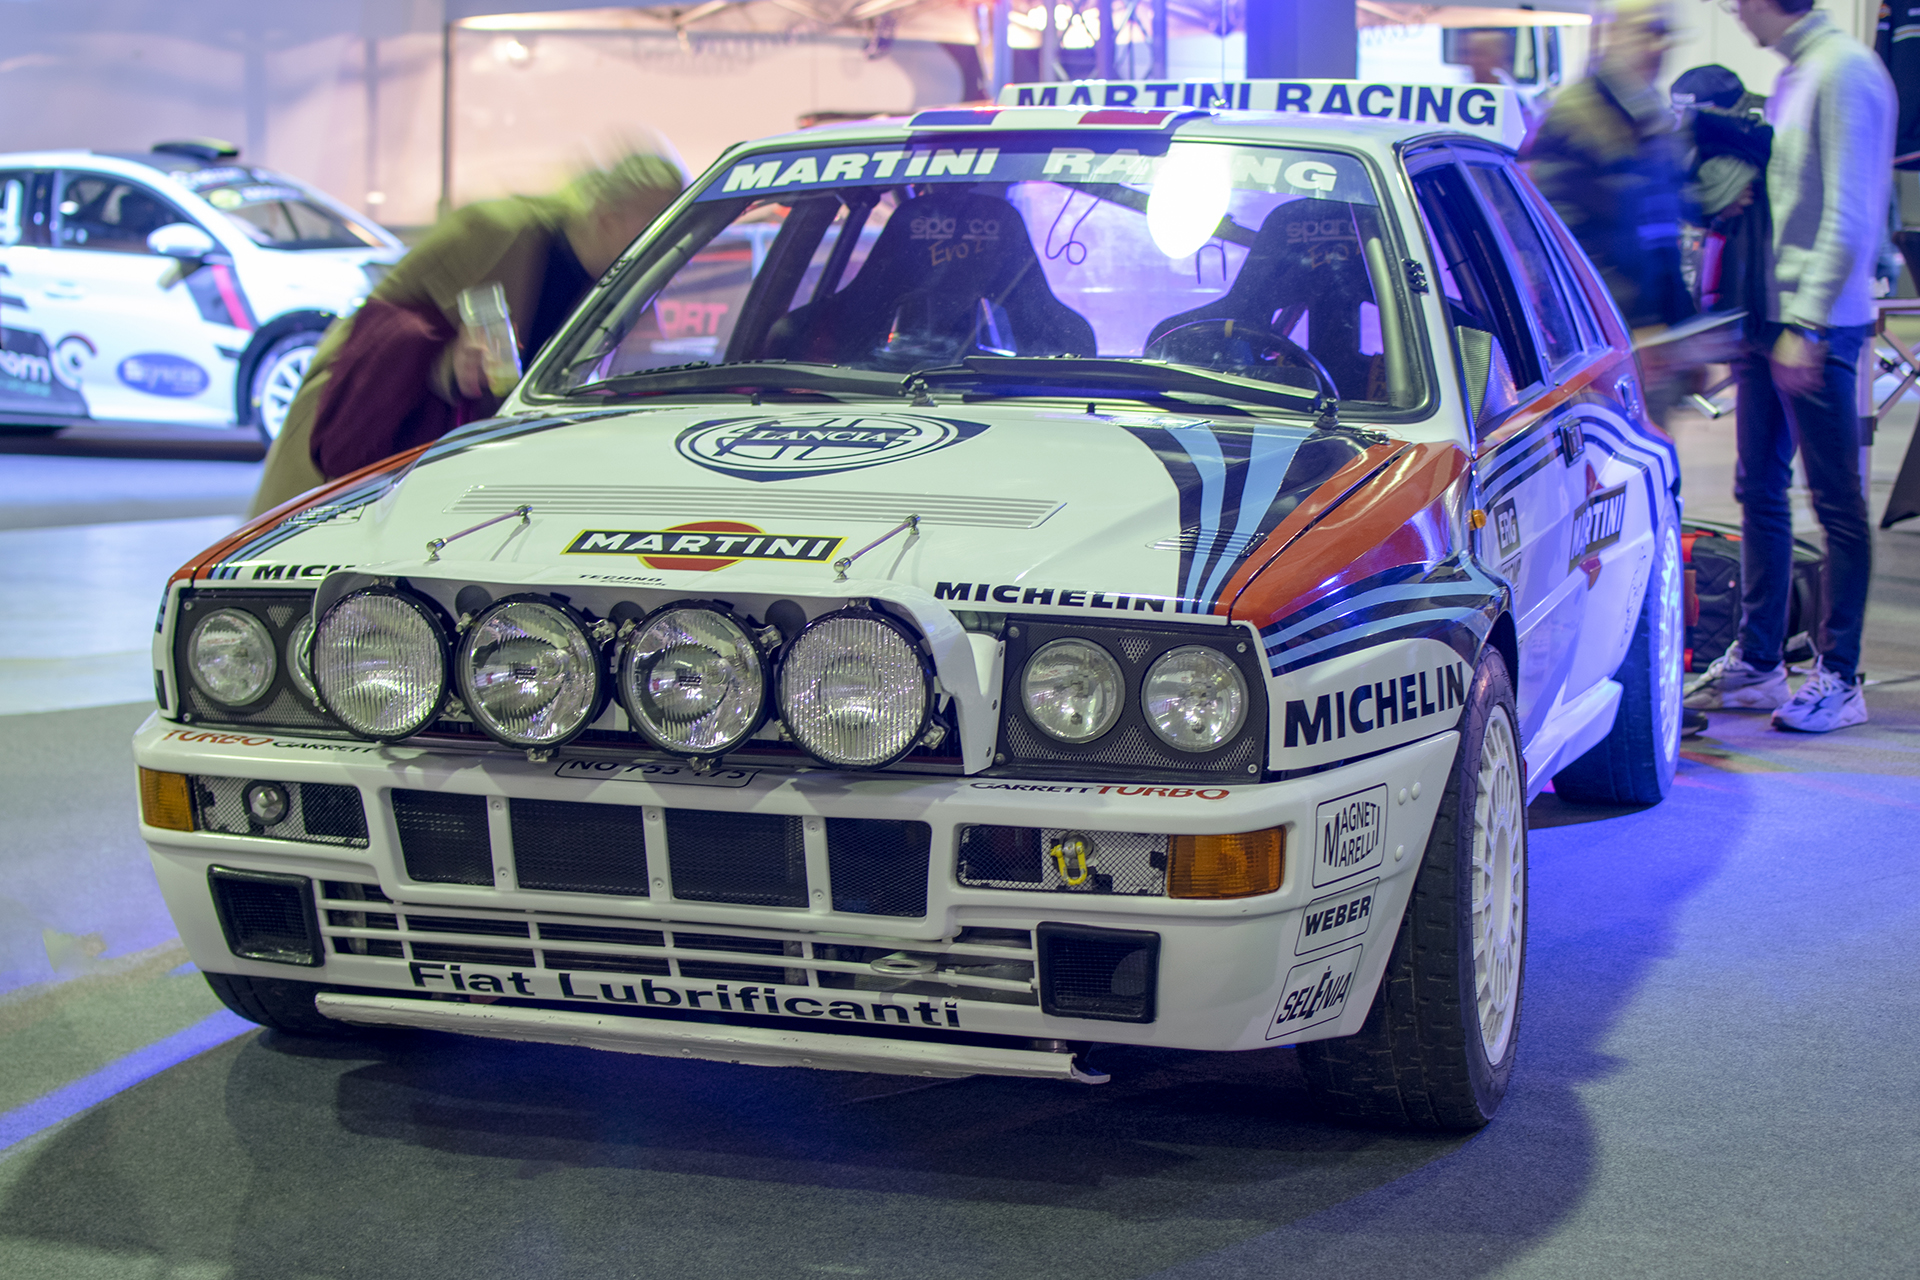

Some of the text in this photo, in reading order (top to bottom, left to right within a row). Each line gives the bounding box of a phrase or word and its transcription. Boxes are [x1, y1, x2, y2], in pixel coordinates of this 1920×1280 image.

[1017, 82, 1497, 126] MARTINI RACING
[722, 148, 1338, 193] MARTINI RANG
[745, 430, 889, 443] LANCIA
[579, 532, 830, 559] MARTINI
[934, 581, 1166, 613] MICHELIN
[1283, 661, 1465, 748] MICHELIN
[163, 729, 275, 746] TURBO
[969, 782, 1231, 801] GARRETT TURBO
[1305, 895, 1372, 937] WEBER
[408, 961, 961, 1028] Fiat Lubrificanti
